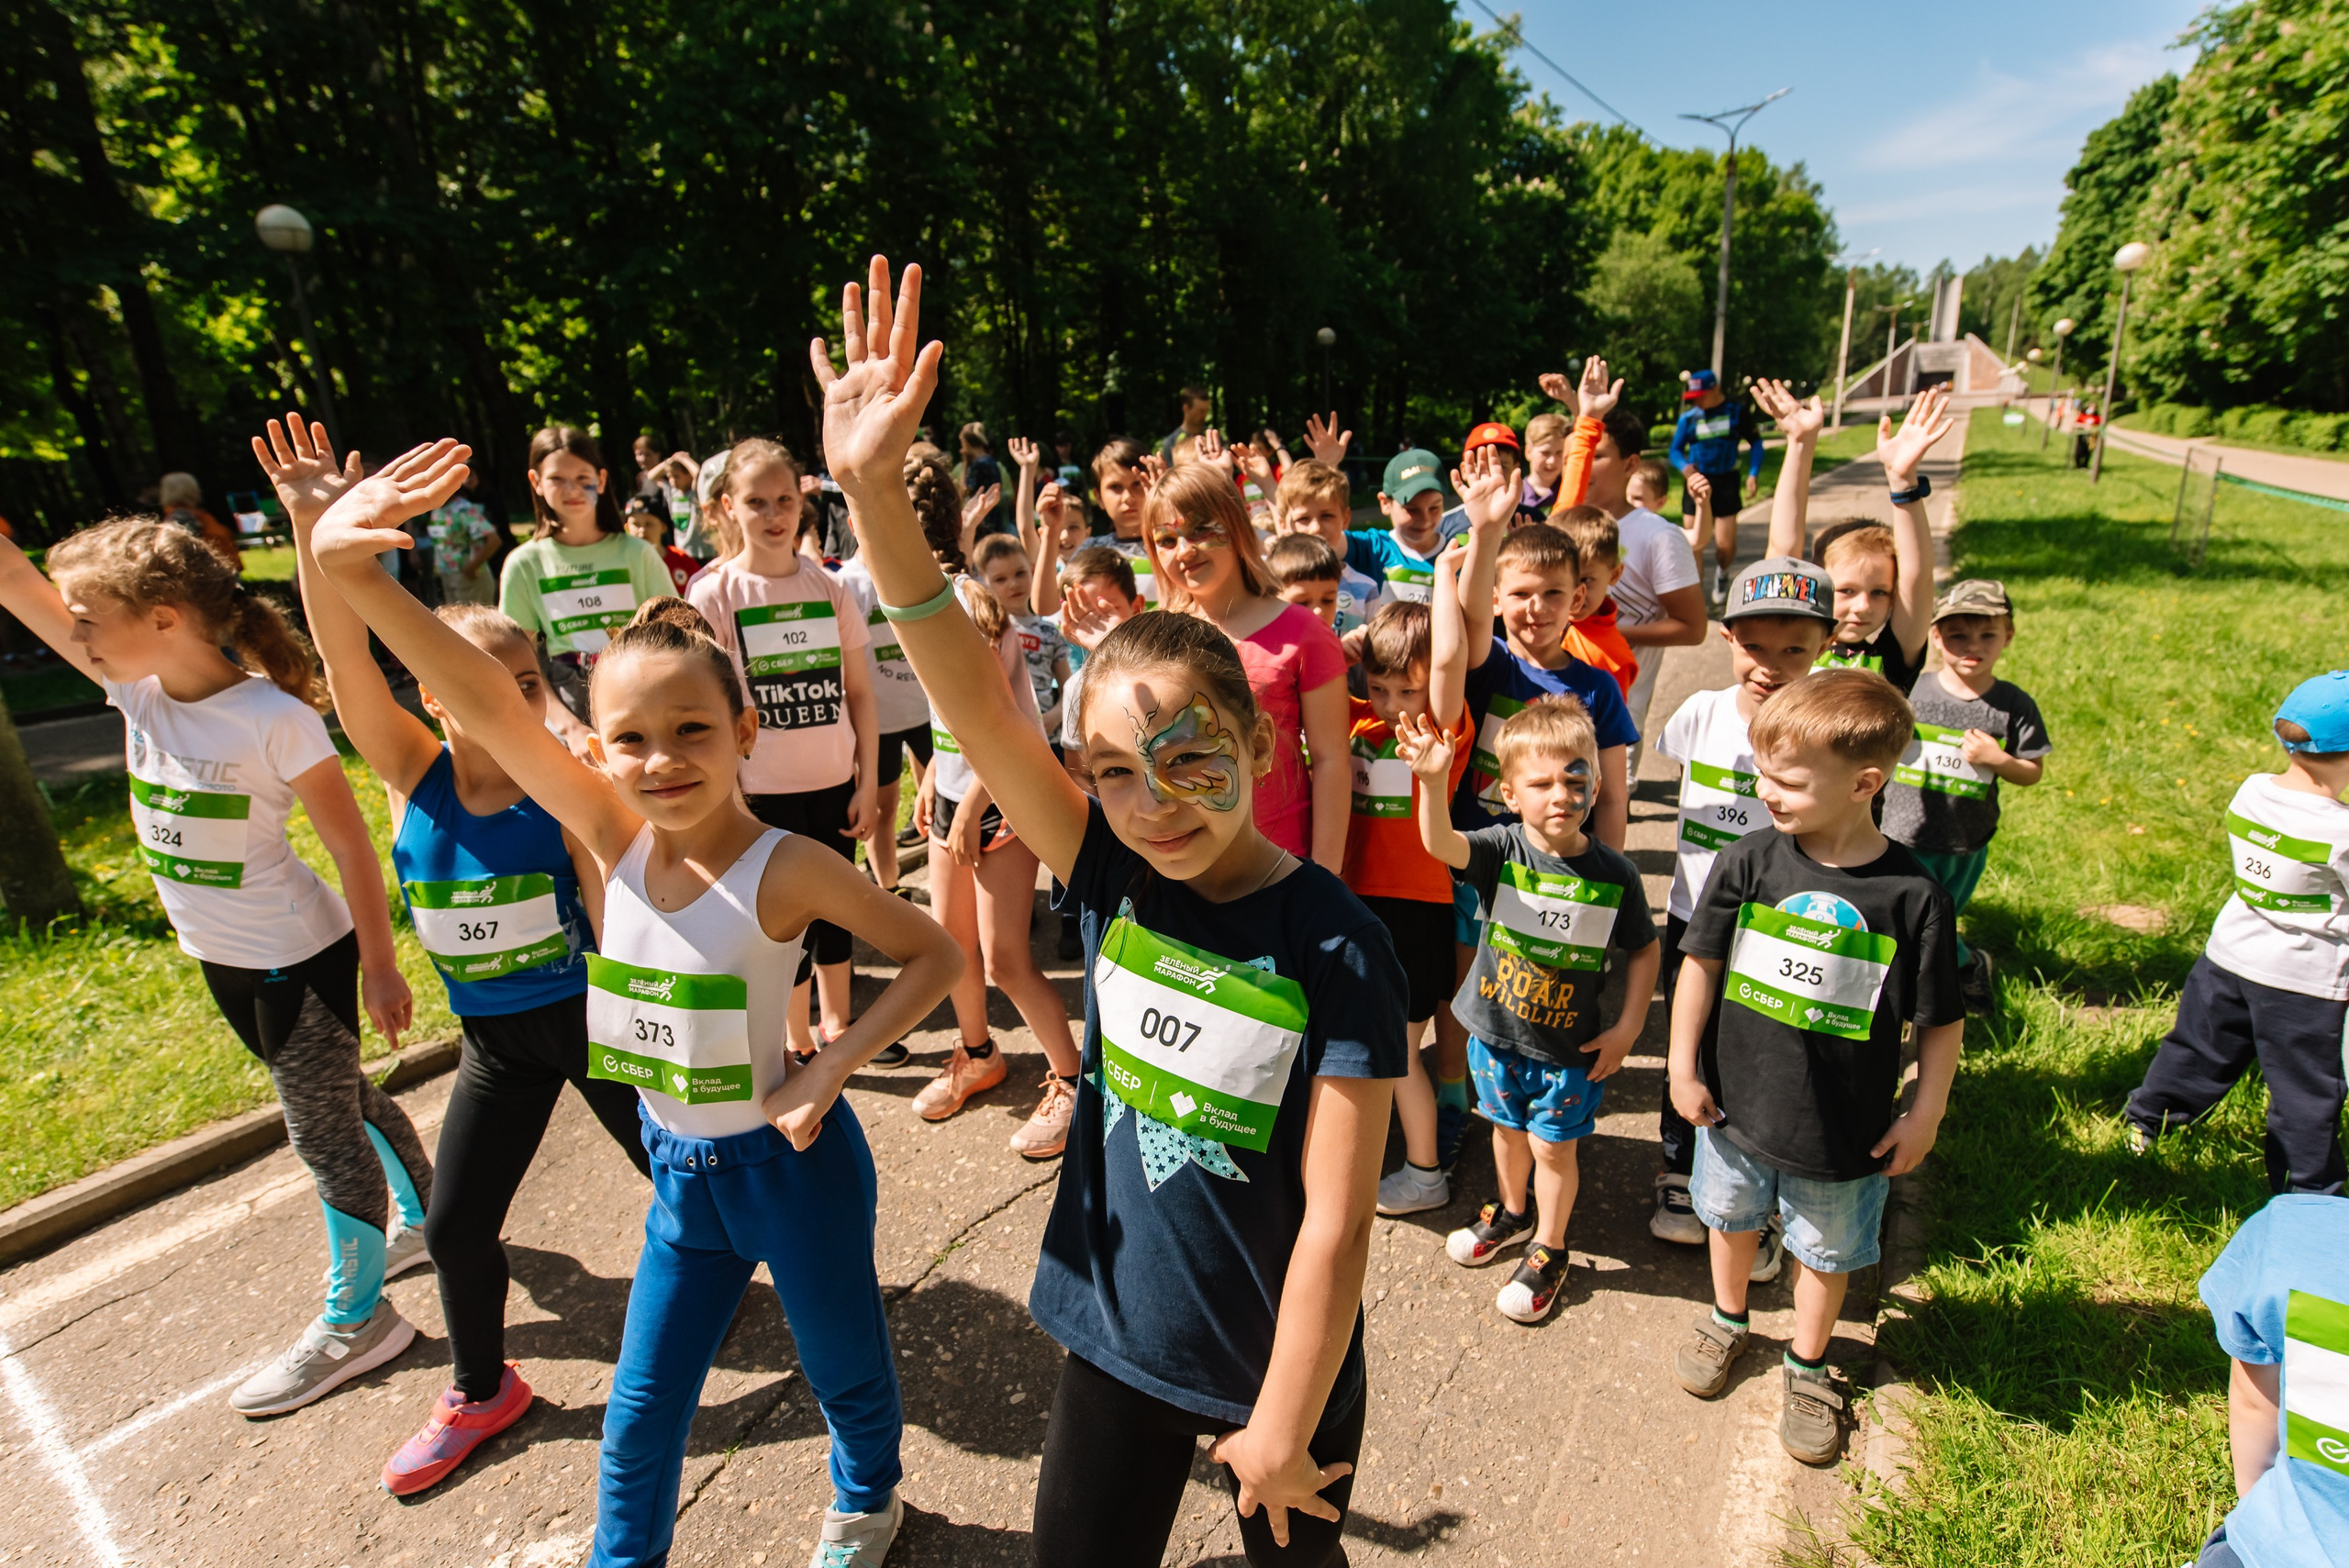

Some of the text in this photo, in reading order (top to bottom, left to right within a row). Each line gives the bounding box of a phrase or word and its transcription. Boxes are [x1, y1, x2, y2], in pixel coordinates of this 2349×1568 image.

[1743, 573, 1818, 605] MARVEL
[577, 595, 602, 608] 108
[783, 630, 807, 645] 102
[877, 664, 893, 678] NO
[754, 679, 840, 705] TikTok
[756, 703, 841, 732] QUEEN
[1935, 754, 1962, 769] 130
[1717, 806, 1748, 826] 396
[151, 825, 183, 847] 324
[2245, 857, 2271, 879] 236
[1538, 910, 1570, 930] 173
[459, 921, 498, 940] 367
[1786, 931, 1817, 944] МАРАФОН
[1789, 924, 1819, 937] ЗЕЛЁНЫЙ
[1160, 955, 1199, 974] ЗЕЛЁНЫЙ
[1779, 958, 1823, 985] 325
[629, 977, 659, 988] ЗЕЛЁНЫЙ
[1154, 965, 1197, 986] МАРАФОН
[1497, 957, 1574, 1009] ROAR
[629, 986, 659, 997] МАРАФОН
[1753, 991, 1783, 1009] СБЕР
[1479, 976, 1578, 1029] WILDLIFE
[1828, 1012, 1849, 1021] Вклад
[1831, 1019, 1861, 1029] будущее
[635, 1018, 674, 1047] 373
[1141, 1007, 1201, 1052] 007
[620, 1062, 653, 1079] СБЕР
[1108, 1059, 1141, 1090] СБЕР
[700, 1083, 740, 1093] будущее
[1203, 1103, 1238, 1120] Вклад
[1199, 1114, 1257, 1135] в будущее
